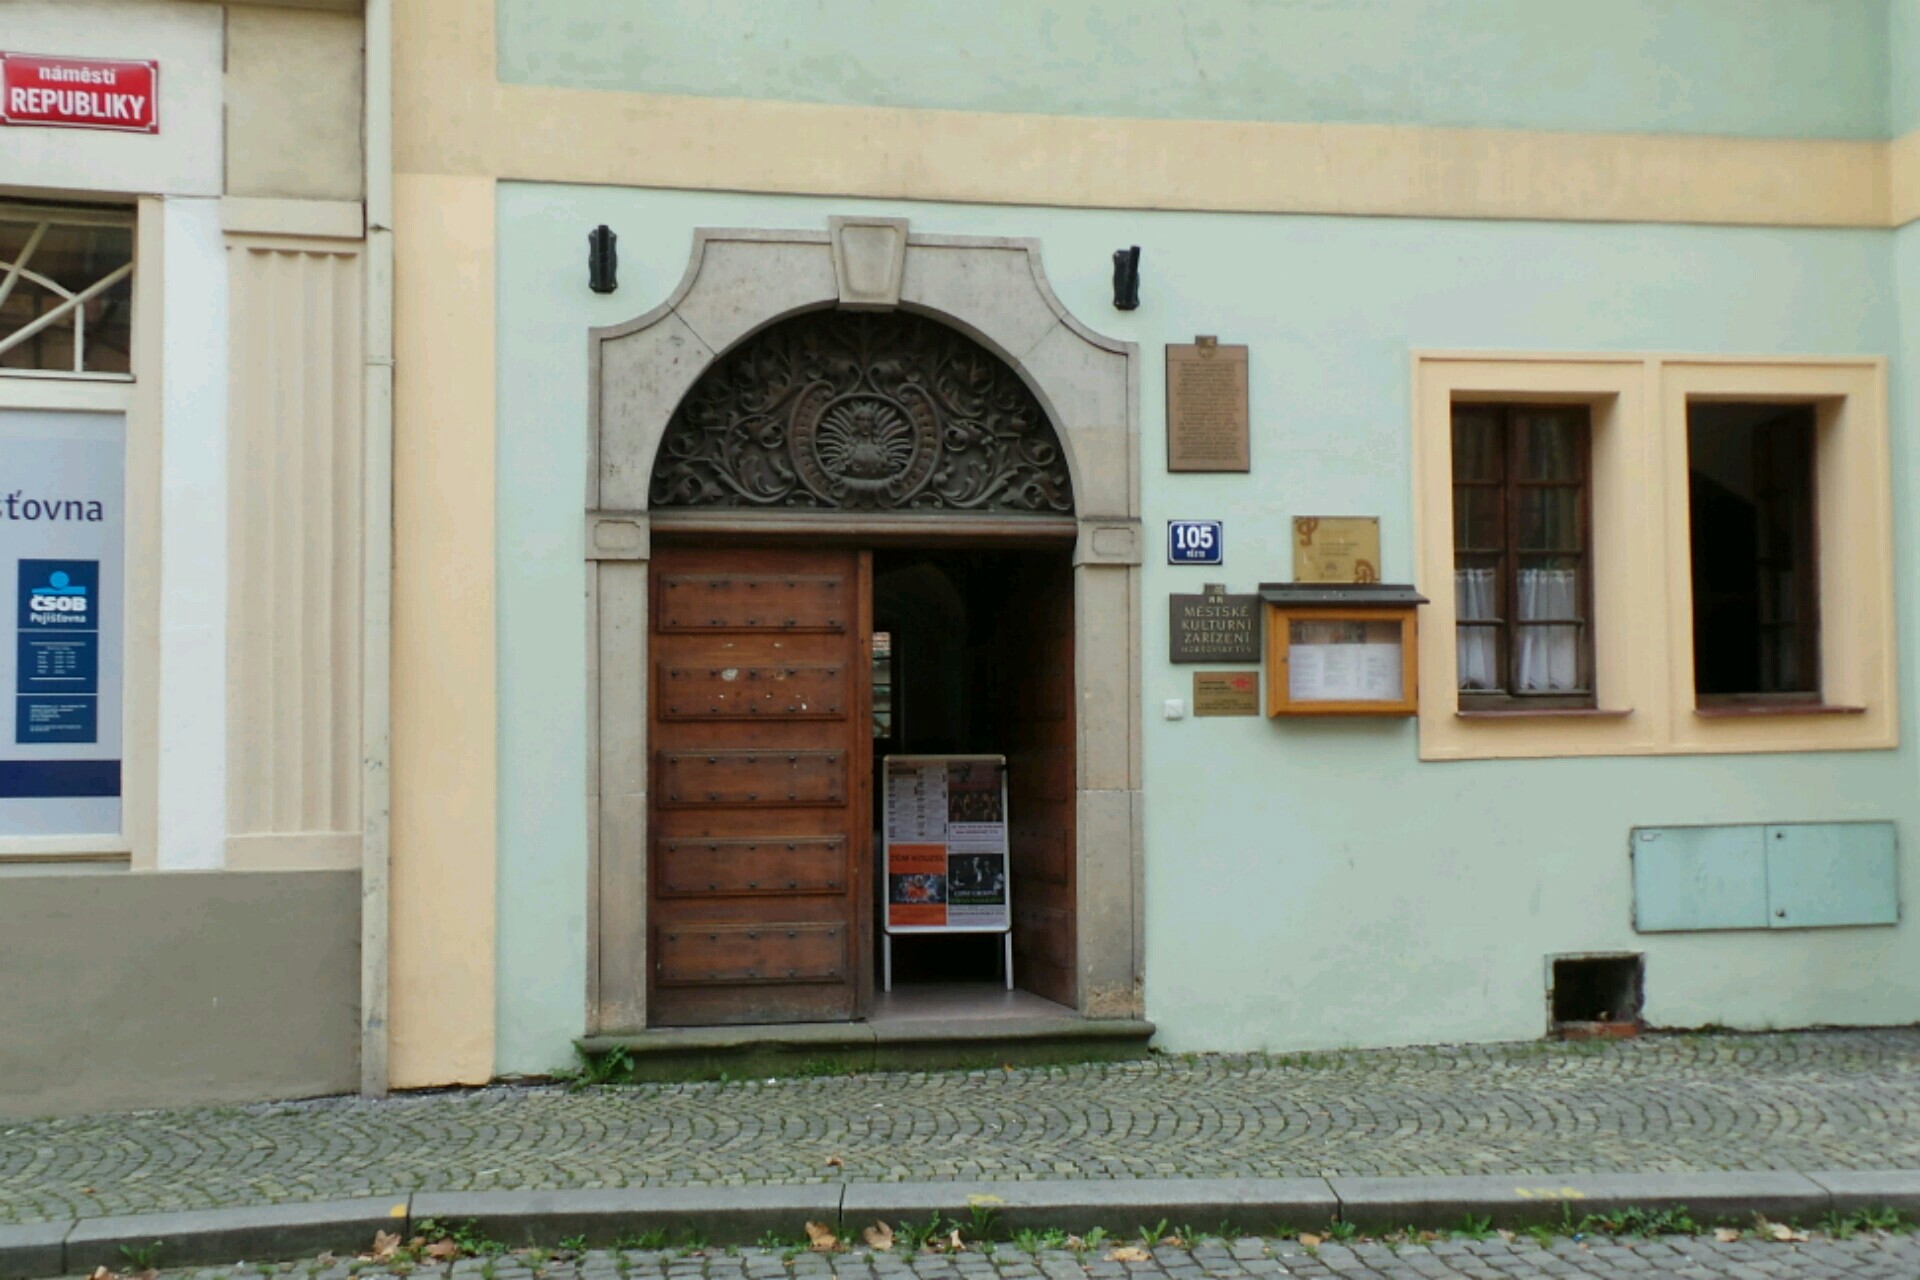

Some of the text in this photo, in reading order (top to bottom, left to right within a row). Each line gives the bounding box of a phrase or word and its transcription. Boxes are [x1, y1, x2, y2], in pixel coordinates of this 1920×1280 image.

[39, 65, 117, 85] náměstí
[11, 87, 145, 120] REPUBLIKY
[0, 490, 103, 521] ťovna
[1176, 526, 1214, 549] 105
[30, 594, 87, 611] ČSOB
